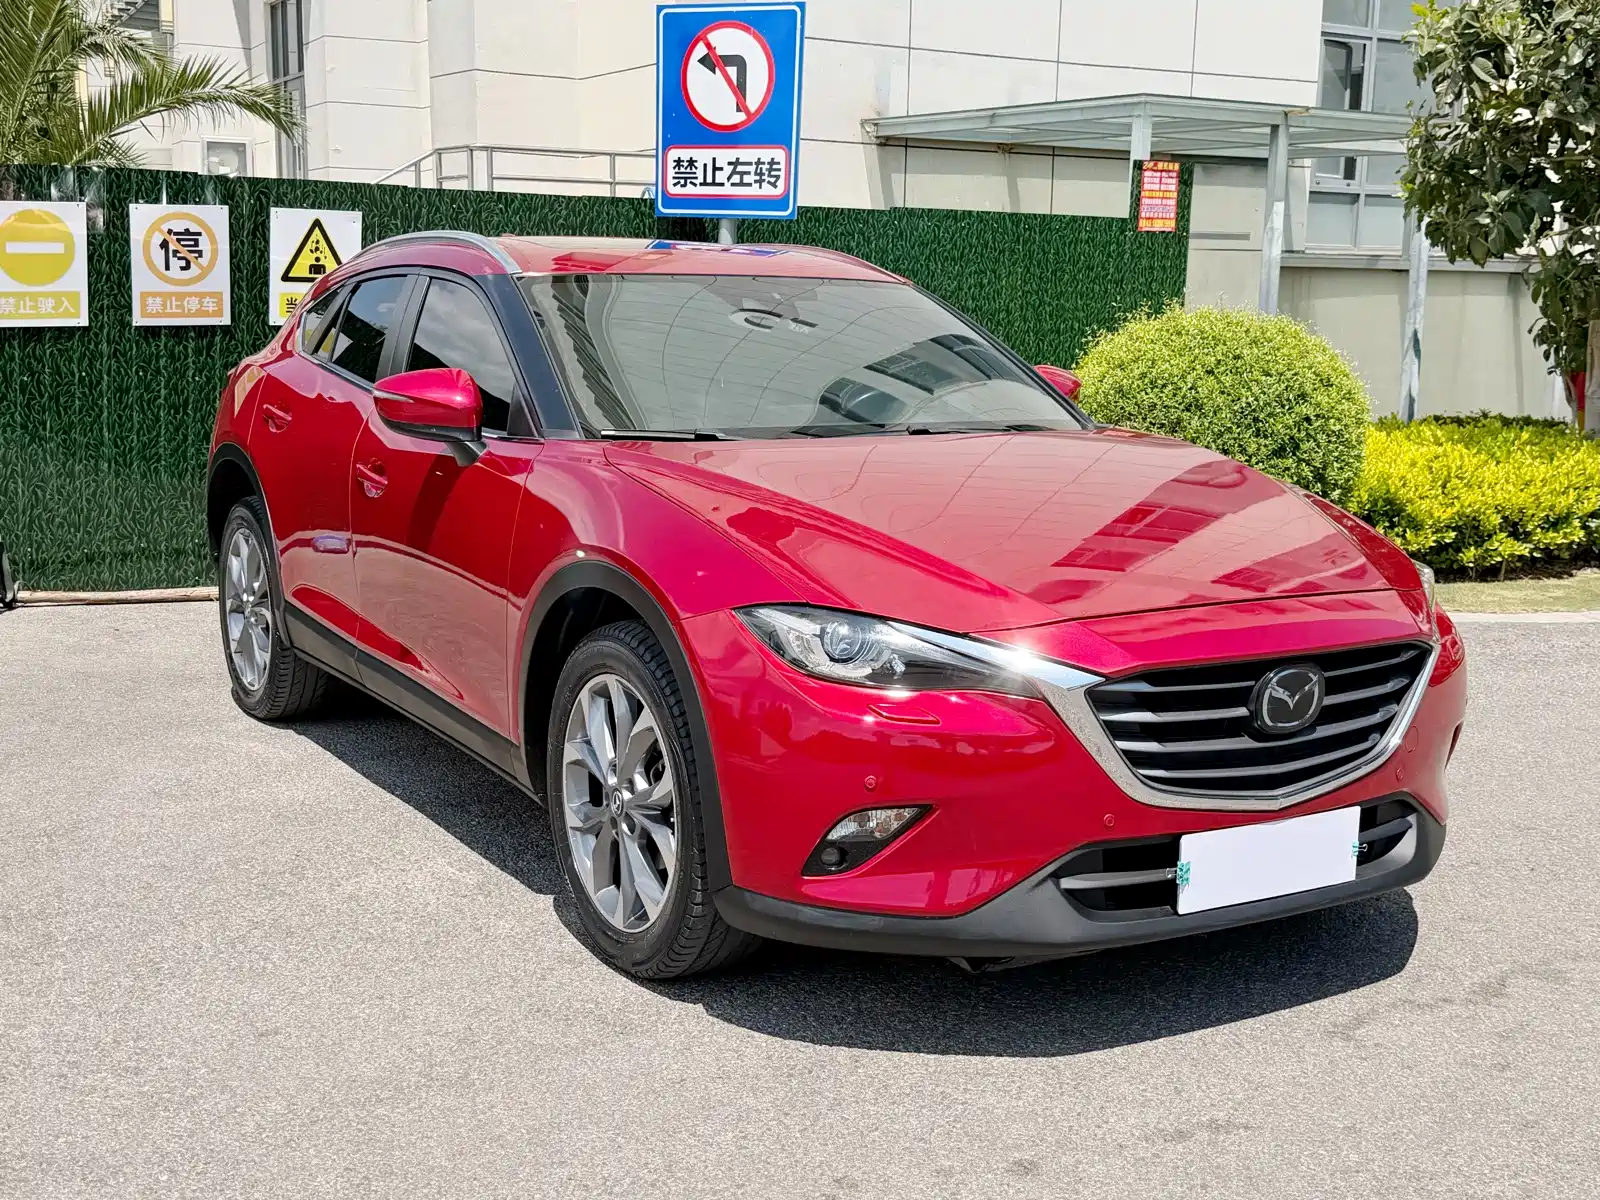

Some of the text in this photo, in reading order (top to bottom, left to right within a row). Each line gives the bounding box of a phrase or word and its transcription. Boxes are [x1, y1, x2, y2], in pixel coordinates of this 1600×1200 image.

[672, 156, 782, 189] 禁止左转
[159, 227, 204, 271] 停
[0, 295, 76, 314] 禁止驶入
[145, 295, 219, 314] 禁止停车
